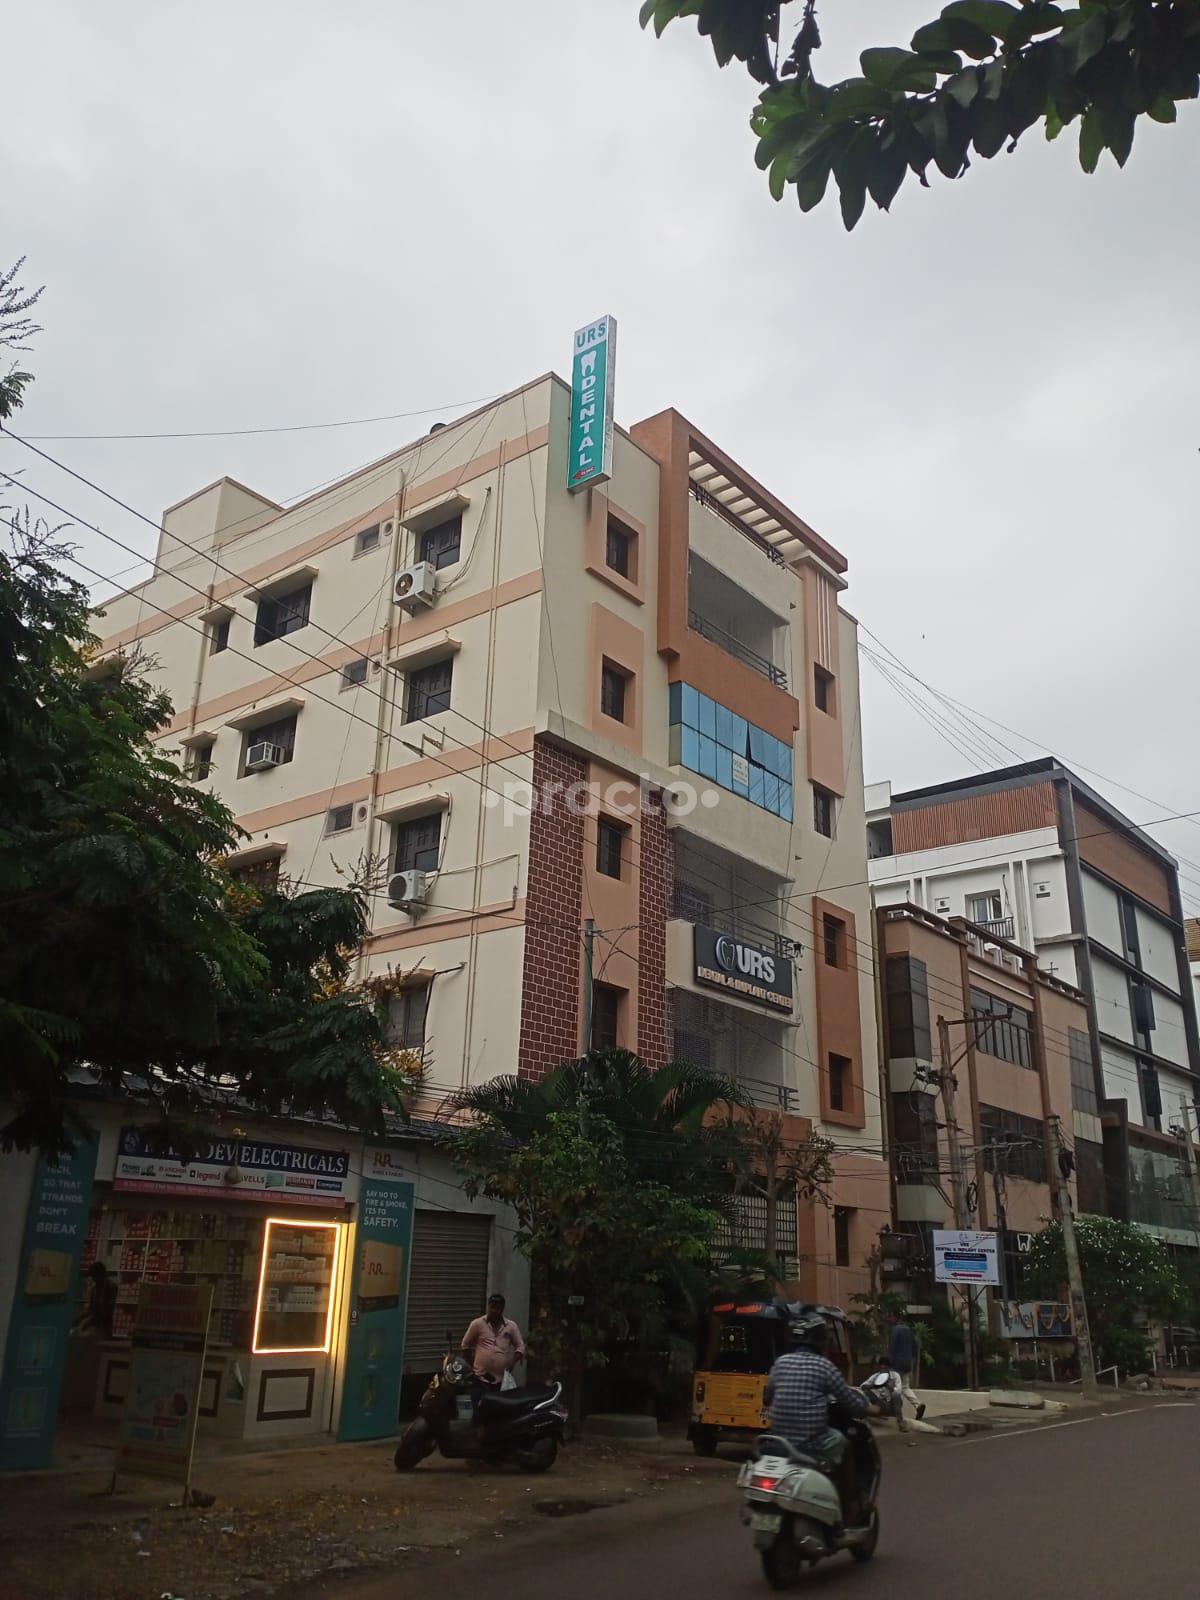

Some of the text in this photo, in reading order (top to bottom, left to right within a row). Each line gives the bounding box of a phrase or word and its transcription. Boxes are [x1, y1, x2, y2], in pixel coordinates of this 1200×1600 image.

[576, 322, 606, 348] URS
[578, 375, 596, 467] DENTAL
[736, 944, 775, 983] URS
[697, 966, 727, 986] DENTAL
[735, 979, 767, 1000] IMPLANT
[240, 1145, 345, 1173] ELECTRICALS
[197, 1169, 221, 1181] legrand
[58, 1180, 82, 1190] THAT
[41, 1192, 84, 1203] STRANDS
[378, 1191, 389, 1199] NO
[390, 1192, 398, 1200] TO
[377, 1208, 387, 1216] TO
[36, 1222, 78, 1235] BREAK
